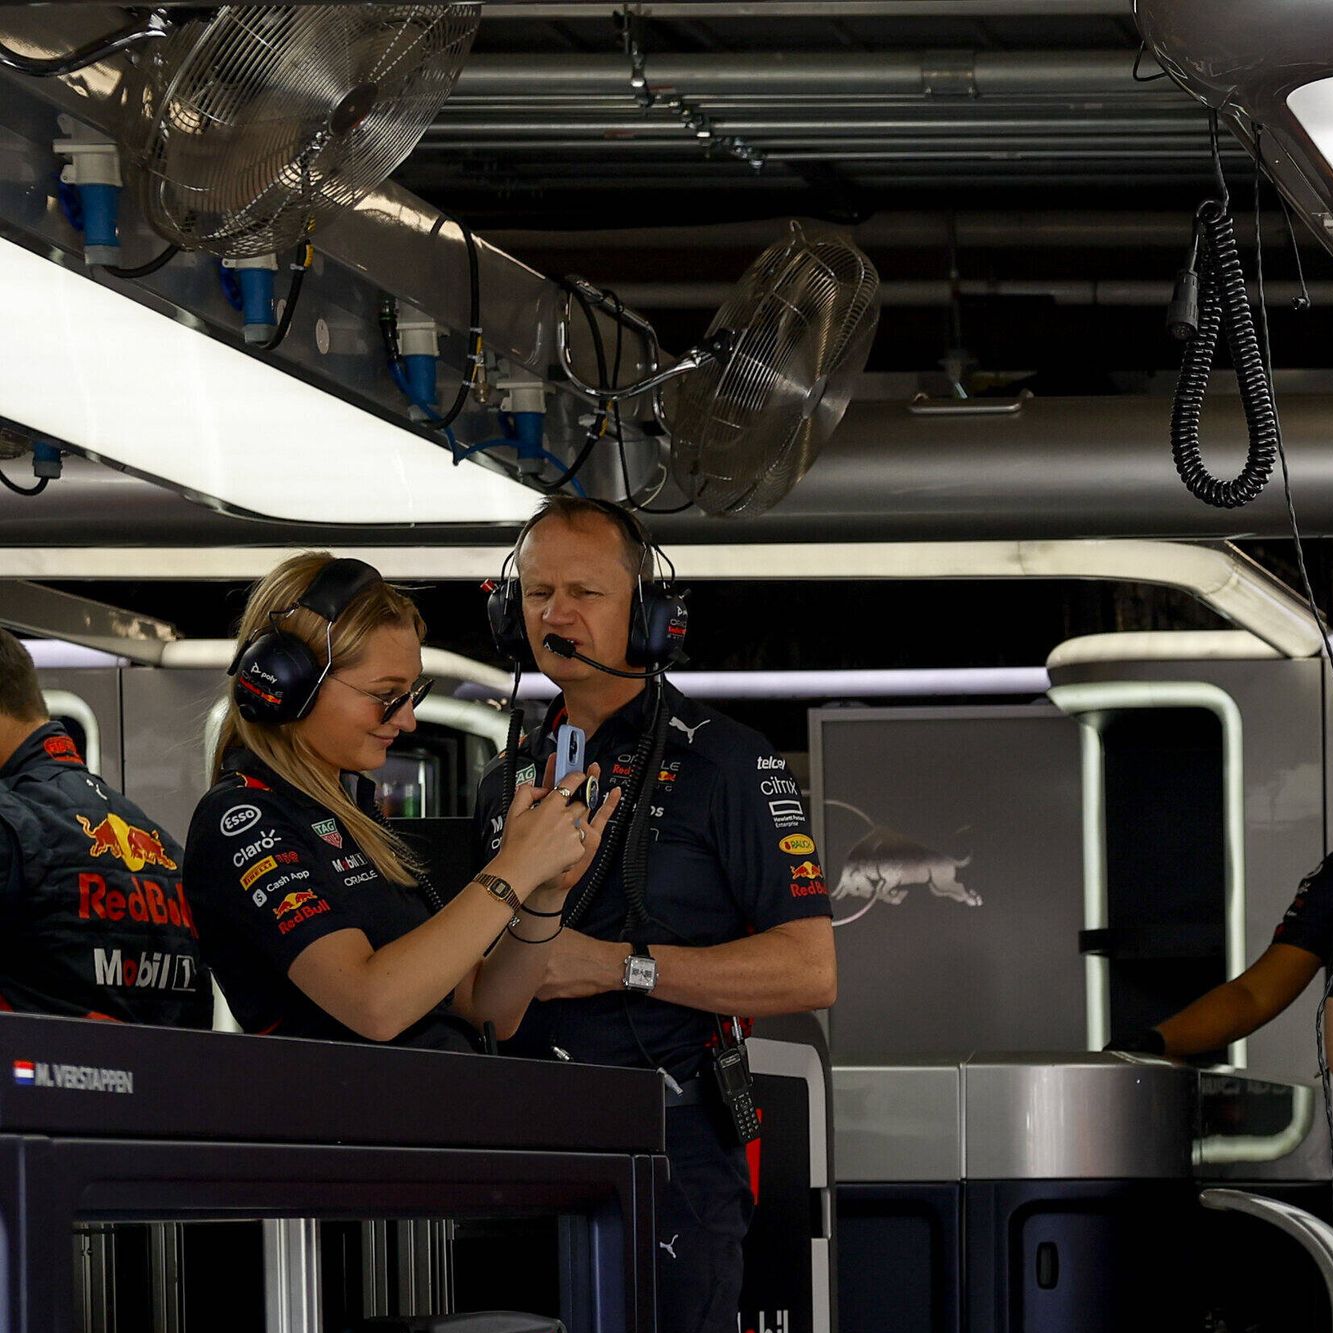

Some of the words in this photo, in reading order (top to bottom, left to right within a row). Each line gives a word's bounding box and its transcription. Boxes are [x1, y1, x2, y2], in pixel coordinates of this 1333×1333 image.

[261, 672, 277, 684] poly
[515, 769, 535, 784] AG
[760, 776, 798, 795] citrix
[315, 821, 335, 834] TAG
[233, 836, 275, 867] Claro
[266, 876, 290, 893] Cash
[291, 870, 310, 883] App
[344, 870, 378, 886] ORACLE
[78, 873, 147, 921] Red
[790, 881, 818, 897] Red
[278, 911, 305, 935] Red
[303, 899, 332, 922] Bull
[94, 948, 170, 989] Mobil
[53, 1064, 133, 1094] VERSTAPPEN
